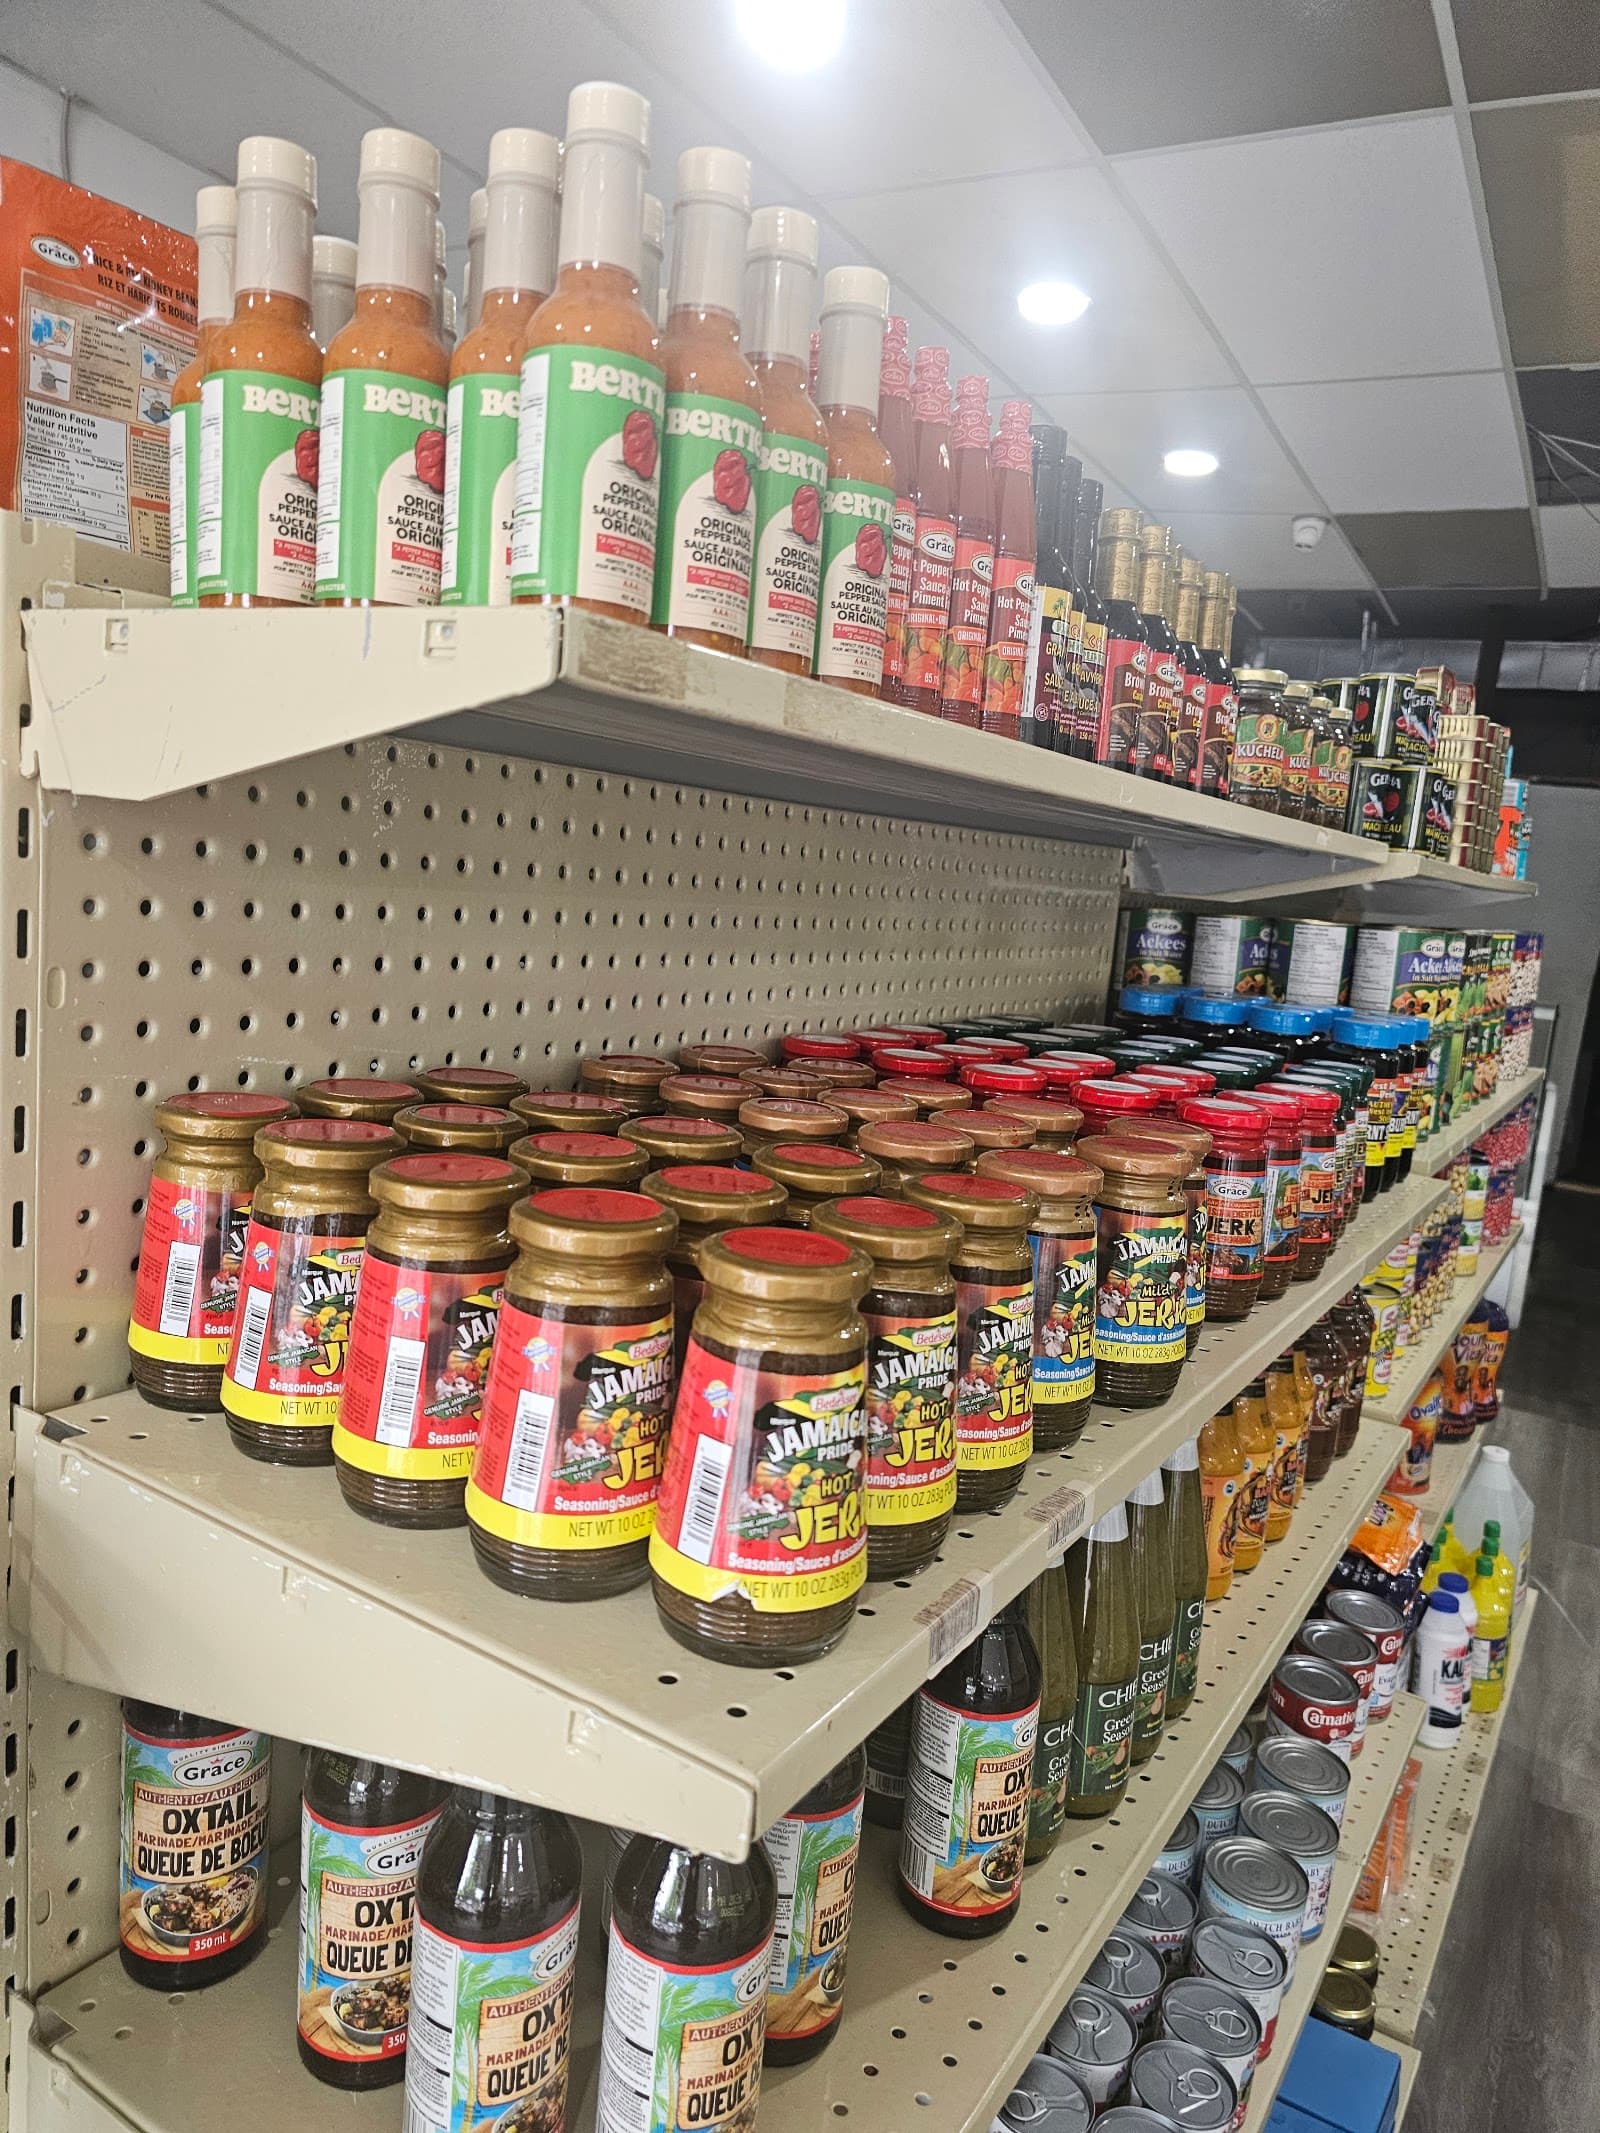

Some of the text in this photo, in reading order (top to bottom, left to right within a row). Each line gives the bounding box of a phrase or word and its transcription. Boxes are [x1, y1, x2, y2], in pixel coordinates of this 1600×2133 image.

[38, 243, 76, 264] Grace
[97, 274, 113, 289] RIZ
[115, 281, 125, 294] ET
[26, 401, 96, 428] Nutrition Facts
[26, 414, 98, 439] Valeur nutritive
[26, 442, 66, 458] Calories 170
[603, 493, 640, 513] PEPPER
[269, 513, 304, 530] SAUCE
[397, 505, 436, 523] PEPPER
[592, 505, 630, 522] SAUCE
[387, 516, 422, 531] SAUCE
[694, 528, 732, 544] PEPPER
[684, 539, 734, 558] SAUCE AU
[766, 567, 797, 582] SAUCE
[775, 557, 808, 574] PEPPER
[920, 561, 951, 578] Pepper
[919, 577, 948, 595] Sauce
[953, 578, 969, 592] Hot
[839, 592, 871, 604] PEPPER
[912, 589, 945, 608] Piment
[997, 595, 1014, 609] Hot
[831, 601, 872, 615] SAUCE AU
[1151, 921, 1180, 932] Grace
[1136, 934, 1187, 951] Ackees
[1218, 1187, 1248, 1197] Grace
[1208, 1218, 1256, 1236] JERK
[1150, 1253, 1177, 1265] PRIDE
[1142, 1284, 1170, 1300] Mild
[1097, 1344, 1170, 1359] NET WT 10 OZ 283g
[1015, 1362, 1032, 1382] HOT
[918, 1373, 949, 1390] PRIDE
[635, 1386, 668, 1405] PRIDE
[969, 1392, 994, 1406] JAMAICAN
[1044, 1386, 1060, 1399] NET
[1062, 1385, 1074, 1397] WT
[1075, 1384, 1082, 1396] 10
[280, 1401, 337, 1415] NET WT 10
[424, 1391, 478, 1416] GENUINE JAMAICAN
[445, 1406, 463, 1416] STYLE
[920, 1402, 948, 1423] HOT
[965, 1403, 982, 1413] STYLE
[639, 1417, 666, 1436] HOT
[767, 1408, 867, 1463] JAMAICA
[816, 1439, 855, 1462] PRIDE
[961, 1442, 1019, 1461] NET WT 10 OZ
[442, 1453, 463, 1468] NET
[572, 1468, 593, 1481] STYLE
[821, 1471, 853, 1498] HOT
[554, 1490, 649, 1513] Seasoning/Sauce
[875, 1487, 943, 1509] WT 10 OZ 283g
[569, 1514, 647, 1538] NET WT 10 OZ
[727, 1551, 831, 1575] Seasoning/Sauce
[743, 1570, 849, 1599] NET WT 10 OZ 283g
[183, 1757, 245, 1781] Grace
[162, 1789, 259, 1835] OXTAIL
[977, 1806, 1021, 1838] QUEUE
[1206, 1818, 1234, 1829] DUTCH
[138, 1817, 255, 1849] MARINADE/MARINADE
[366, 1836, 404, 1853] QUALITY
[138, 1845, 195, 1878] QUEUE
[200, 1845, 226, 1875] DE
[193, 1937, 213, 1952] 350
[327, 1942, 388, 1973] QUEUE
[387, 2031, 406, 2048] 350
[487, 2052, 550, 2098] QUEUE
[687, 2074, 748, 2121] QUEUE
